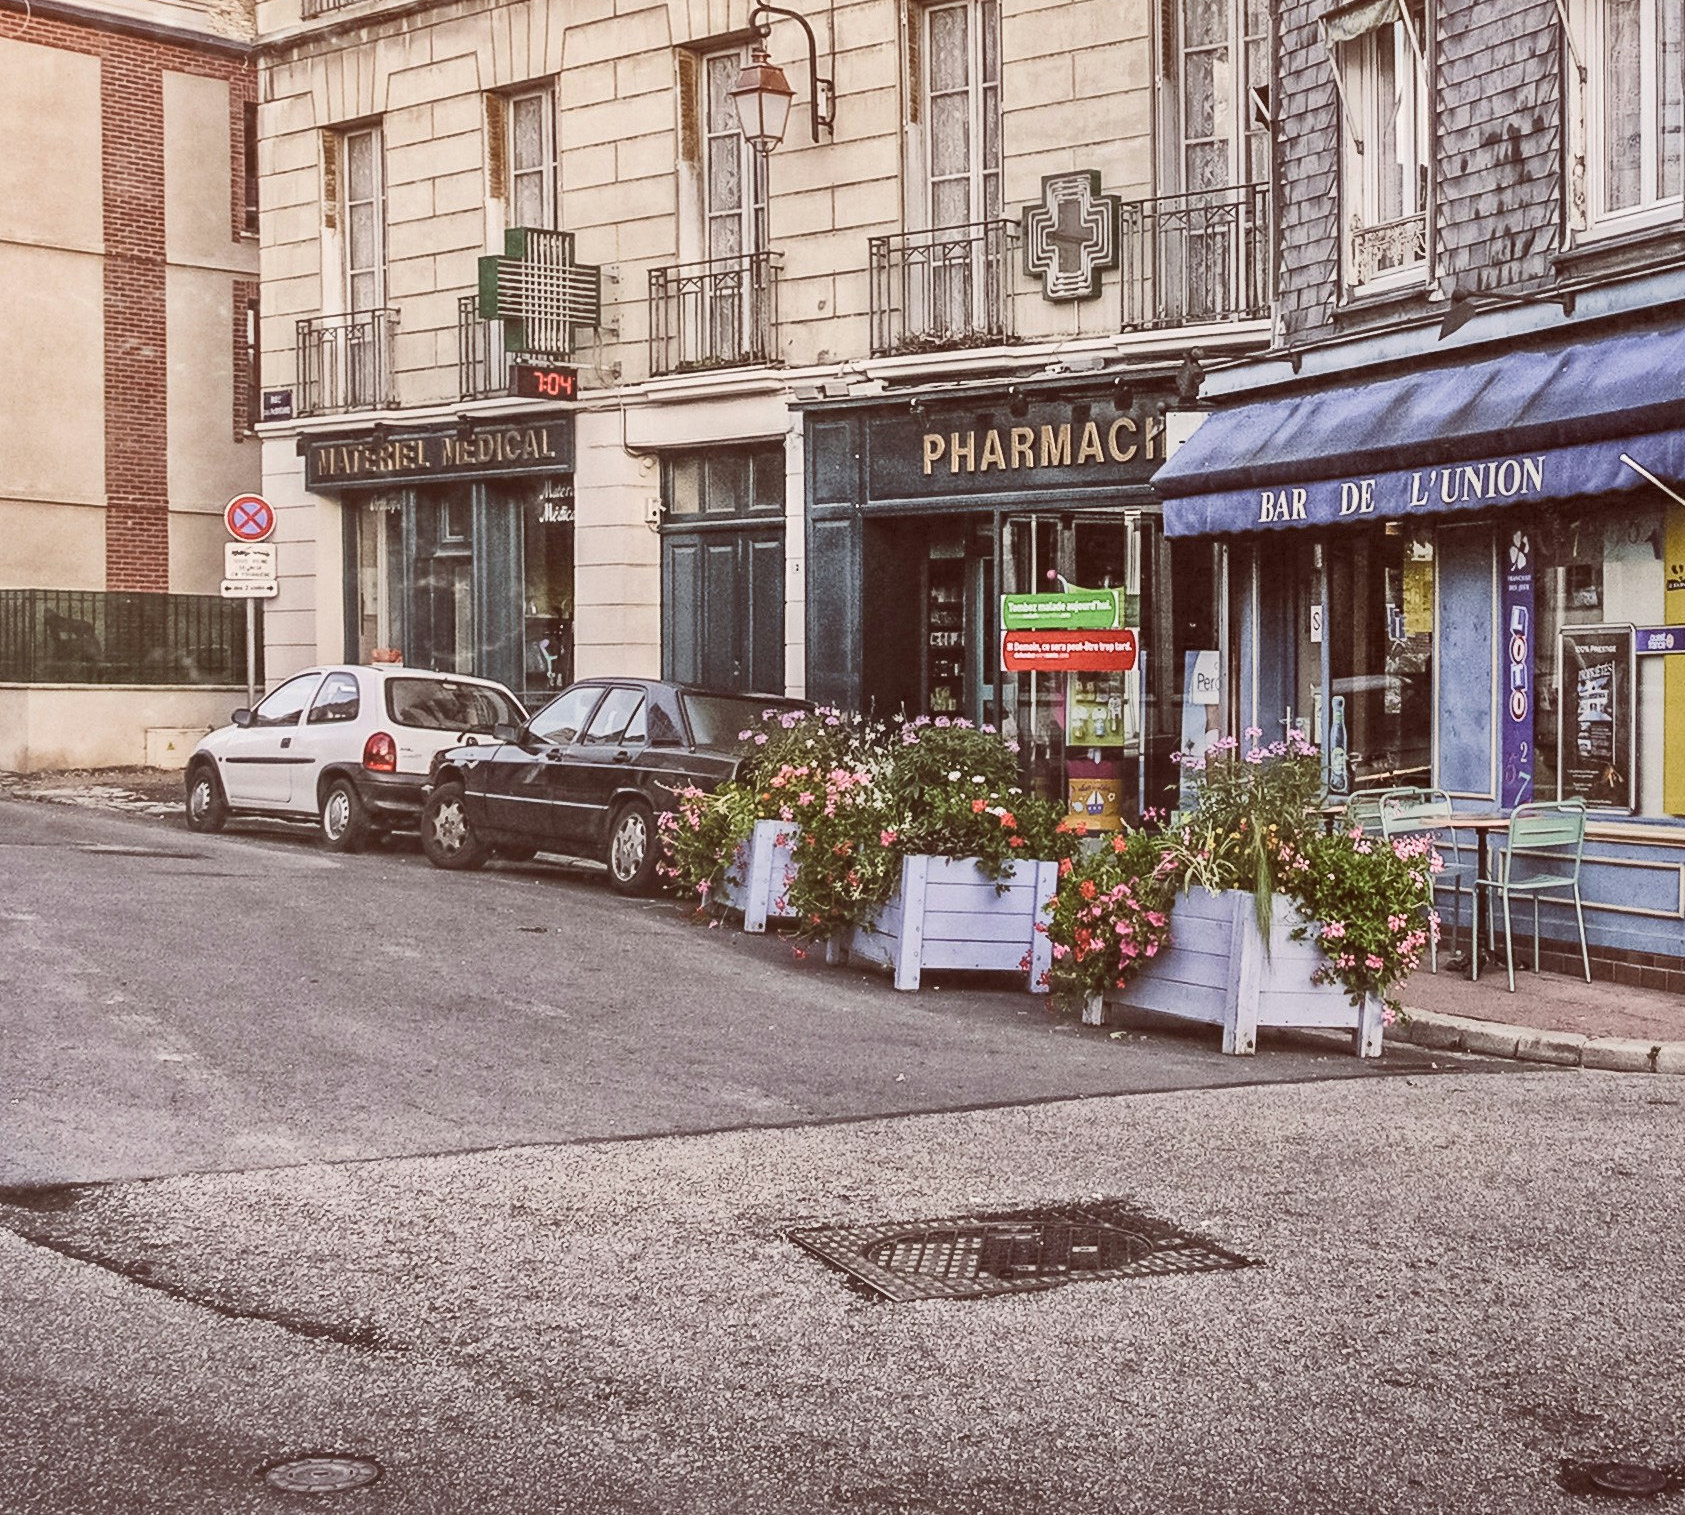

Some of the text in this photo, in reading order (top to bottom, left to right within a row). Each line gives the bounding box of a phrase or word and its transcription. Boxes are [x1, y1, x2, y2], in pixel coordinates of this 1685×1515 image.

[533, 371, 572, 396] 7:04
[1257, 456, 1546, 523] BAR DE L'UNION
[1509, 605, 1529, 723] LOTO
